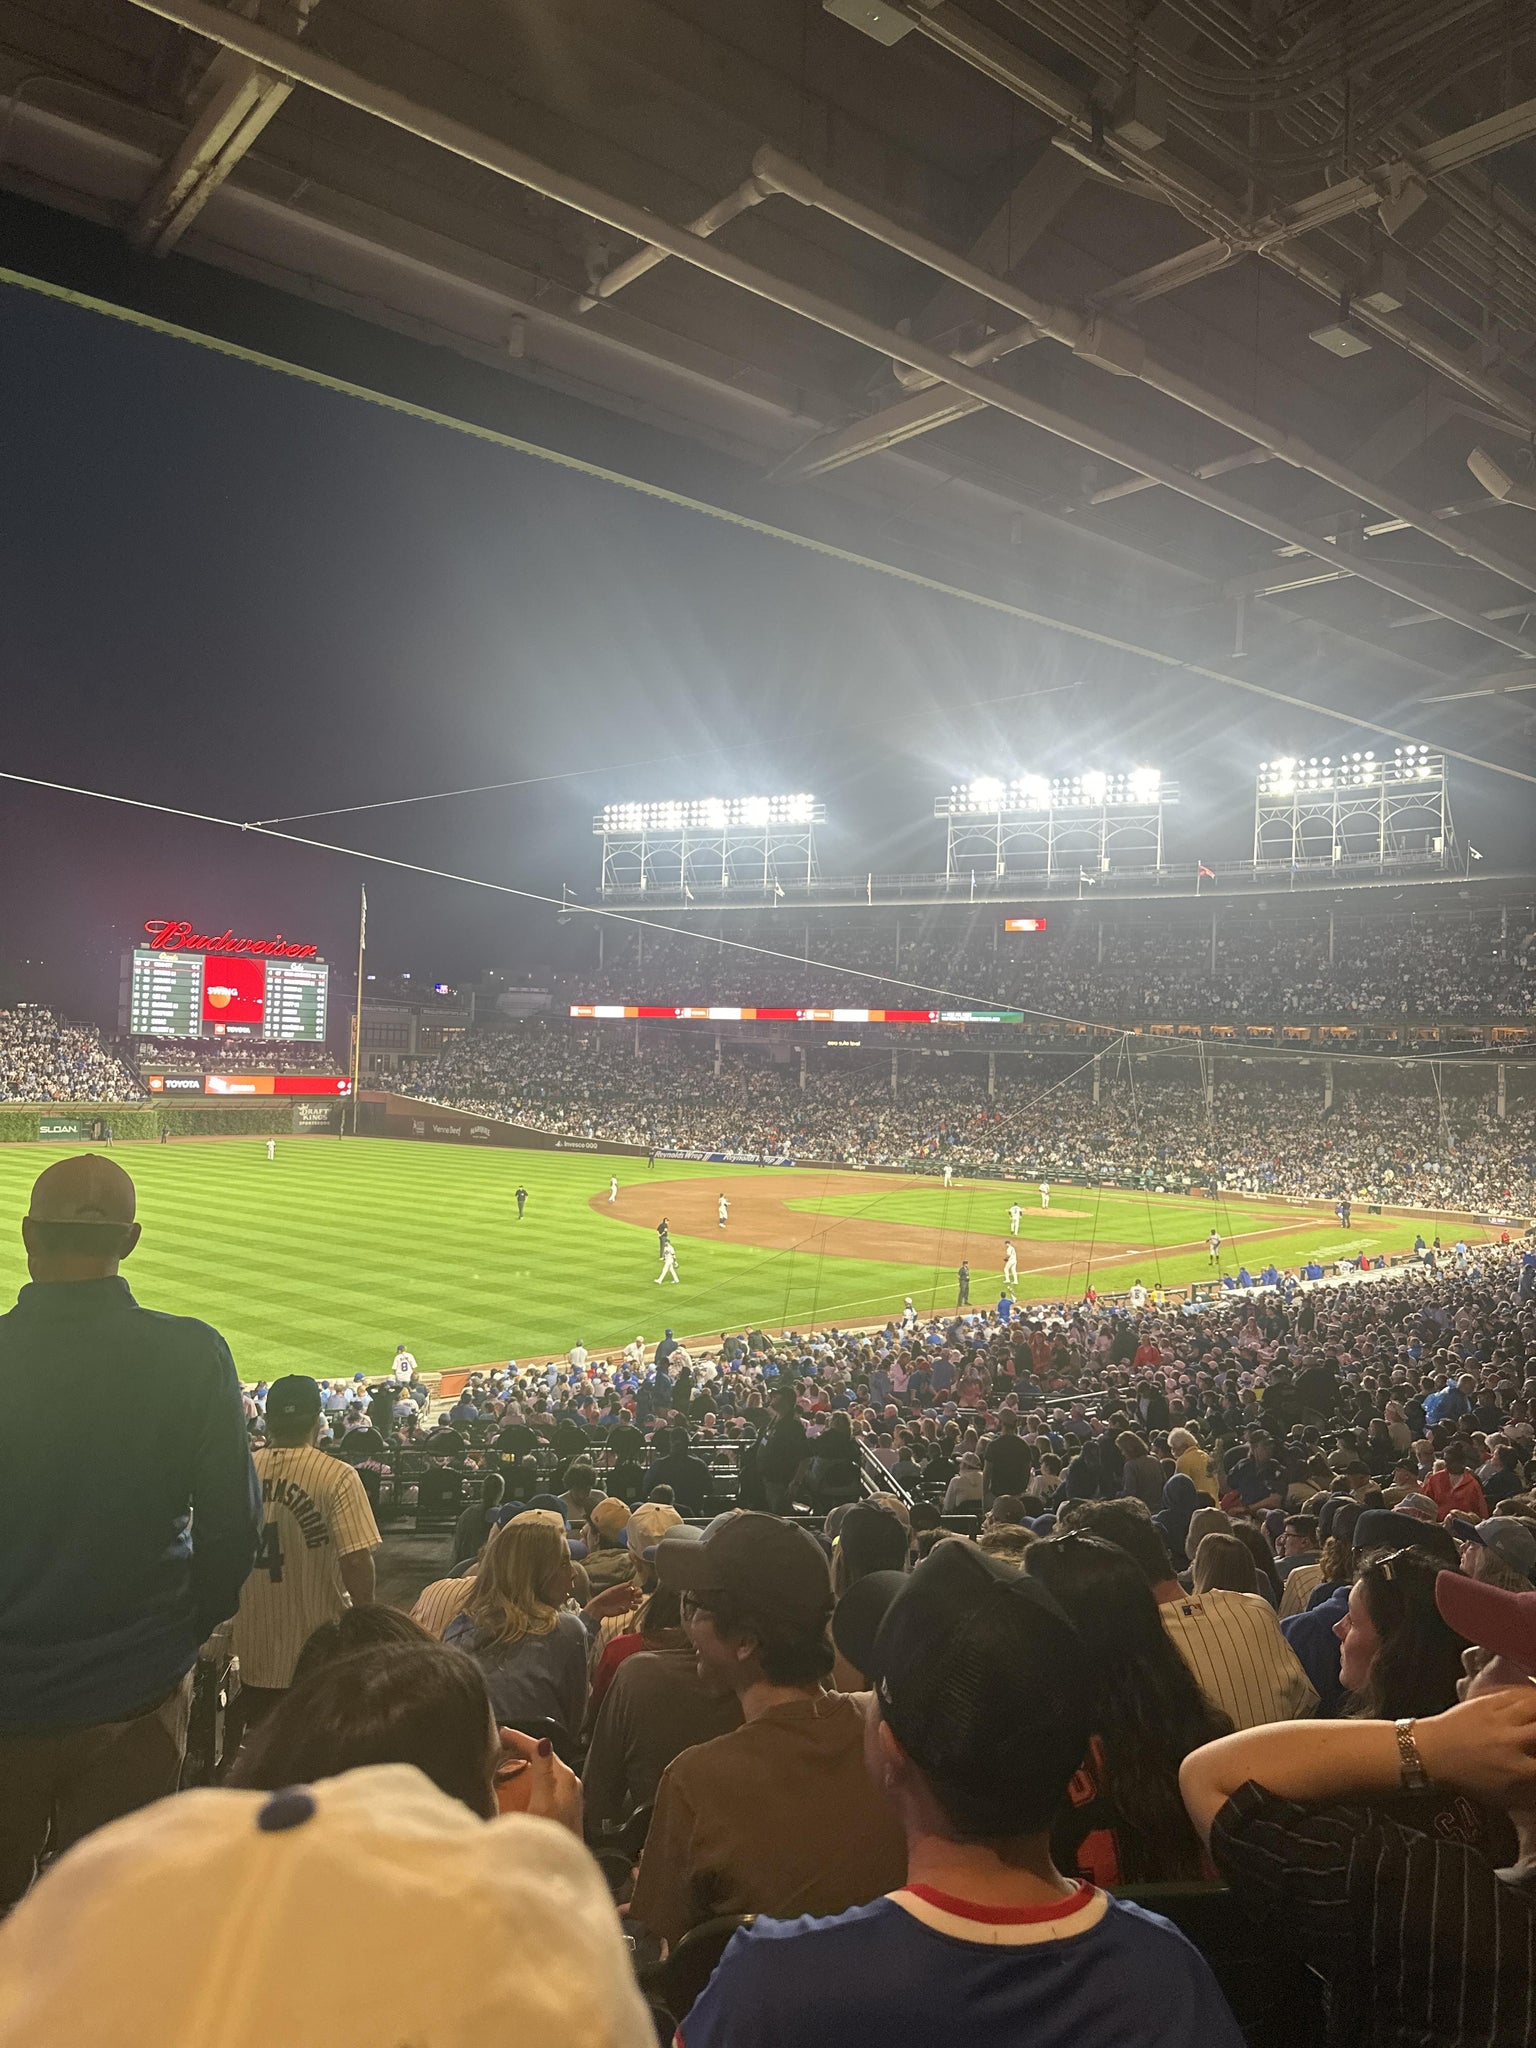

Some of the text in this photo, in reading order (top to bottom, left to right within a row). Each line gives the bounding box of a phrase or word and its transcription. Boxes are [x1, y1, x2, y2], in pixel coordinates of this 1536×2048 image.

[144, 920, 317, 958] Budweiser
[165, 1080, 200, 1089] TOYOTA
[401, 1361, 408, 1371] 8
[262, 1478, 330, 1549] RMSTRONG
[254, 1521, 284, 1583] 4
